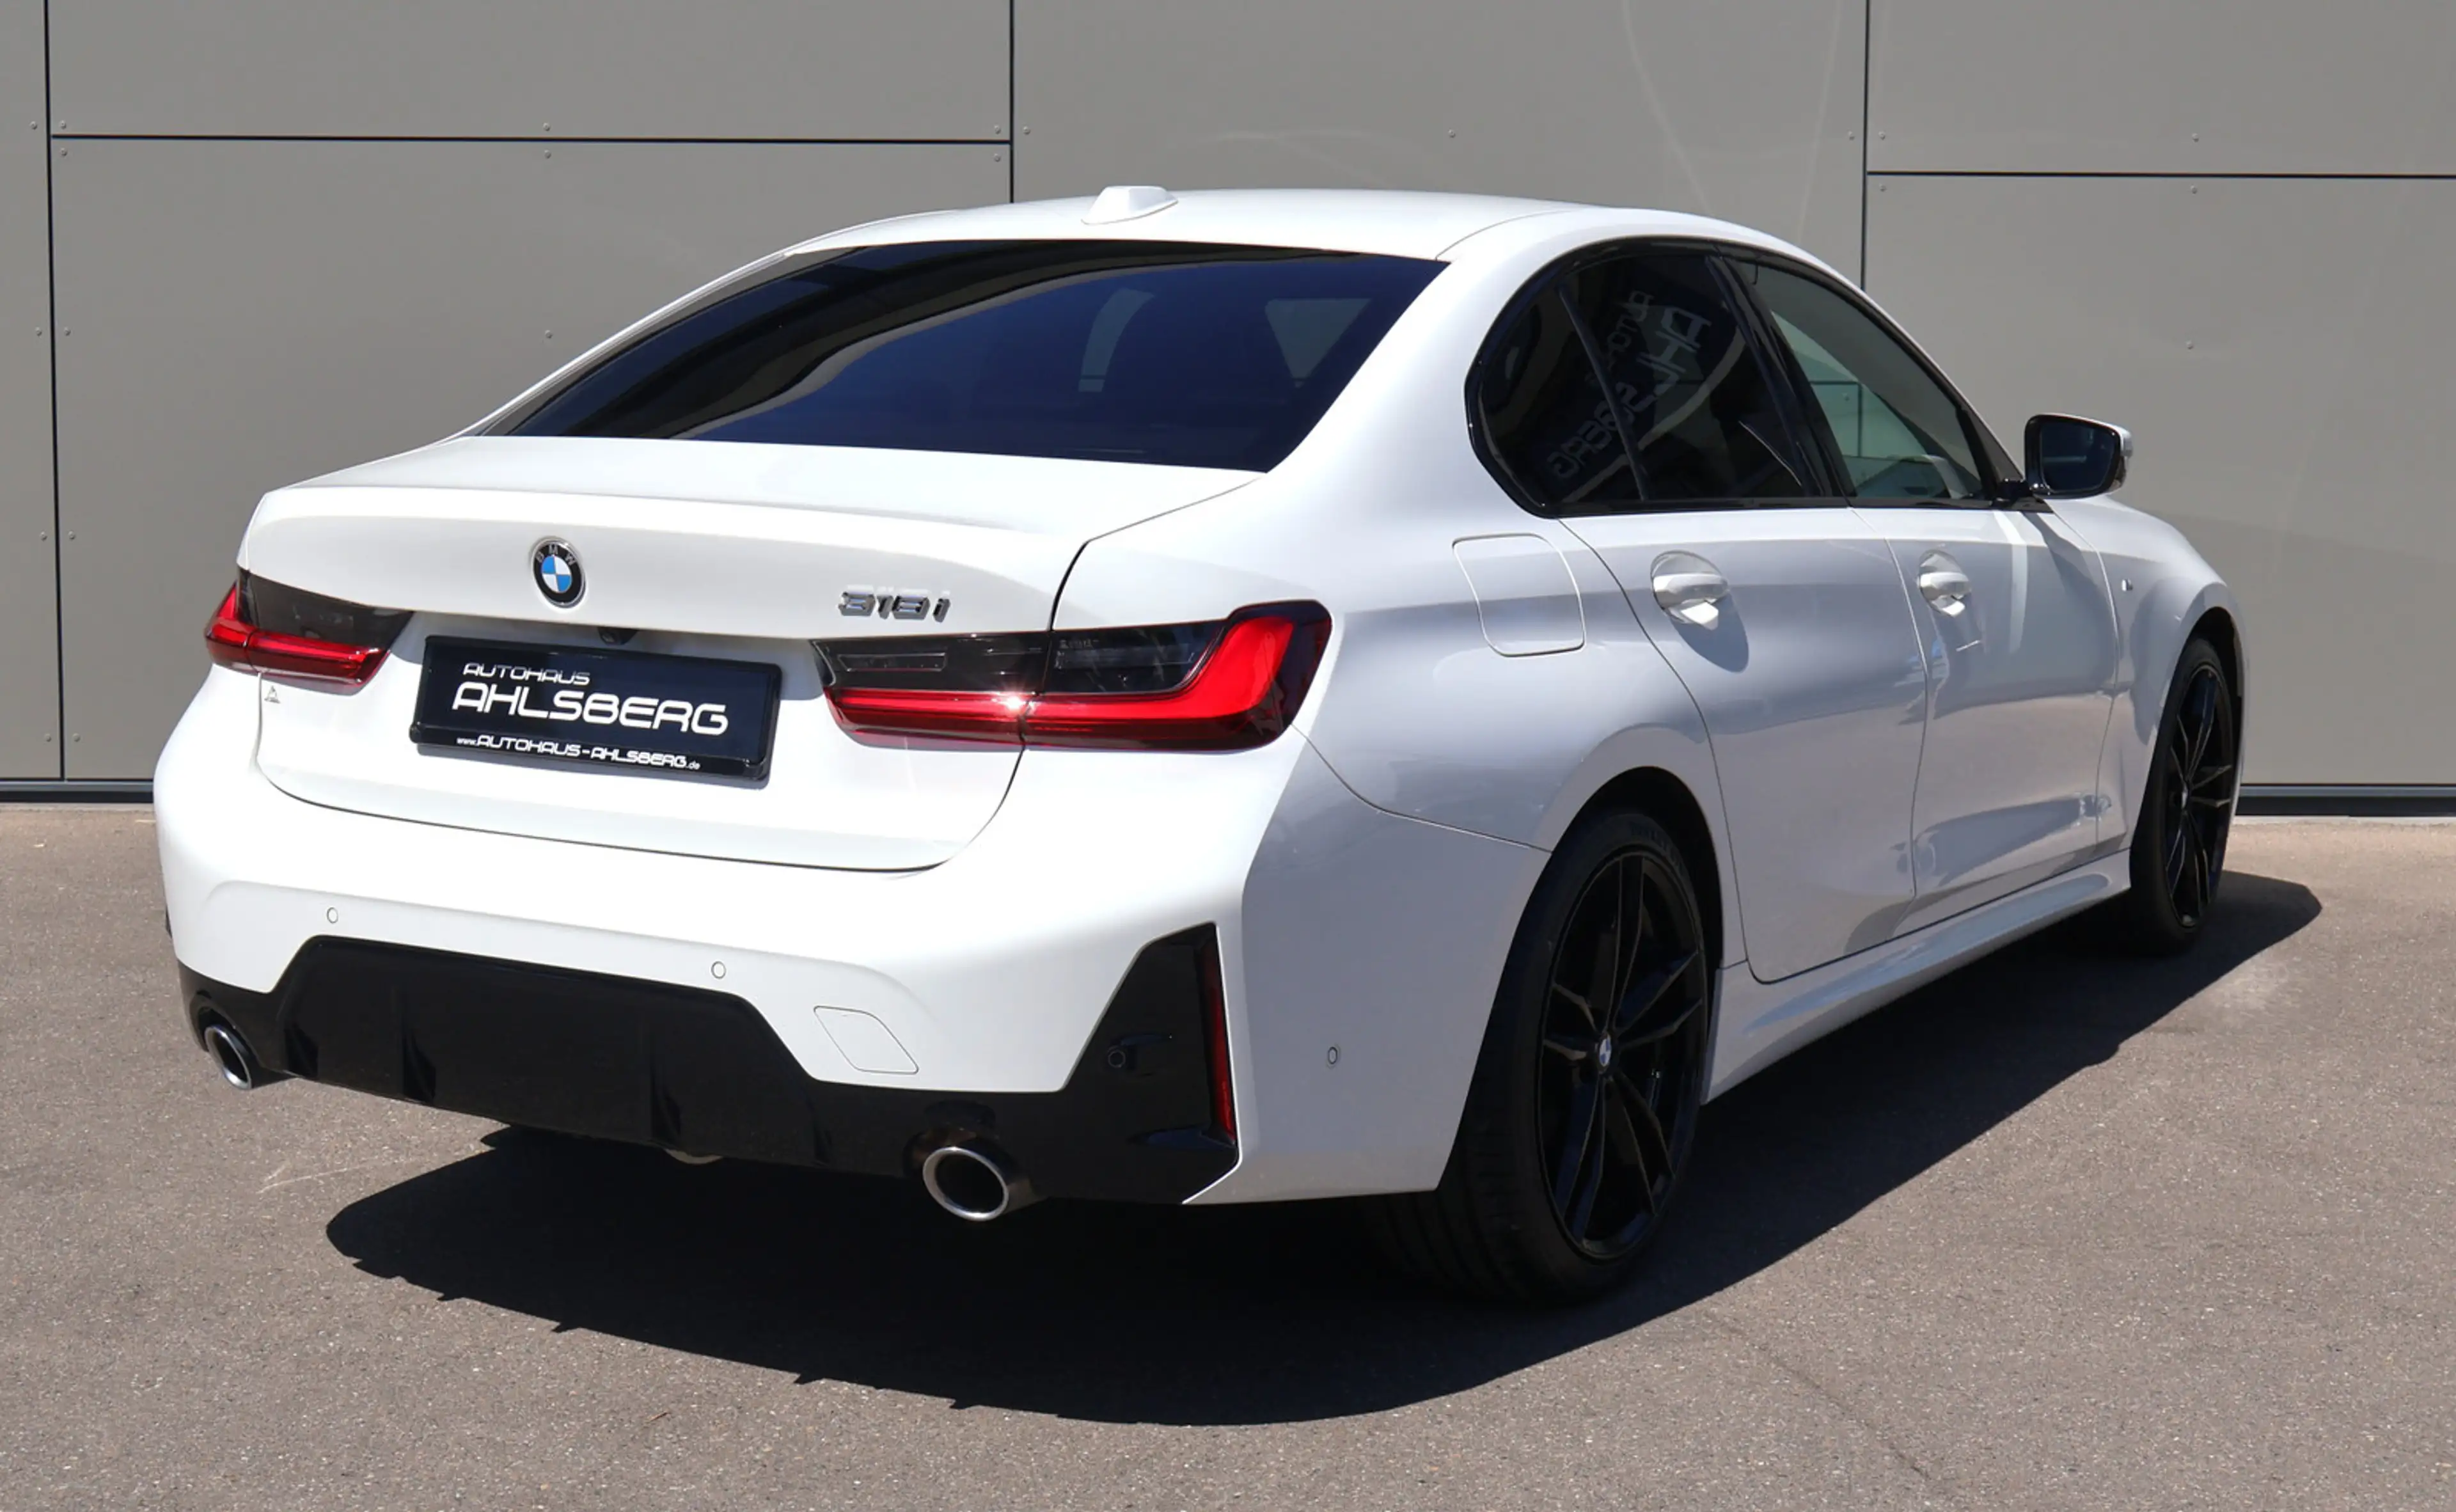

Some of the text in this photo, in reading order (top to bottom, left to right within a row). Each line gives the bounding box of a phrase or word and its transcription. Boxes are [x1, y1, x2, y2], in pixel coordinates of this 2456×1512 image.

[838, 590, 952, 623] 318i
[462, 662, 590, 686] AUTOHAUS
[452, 681, 728, 736] AHLSBERG
